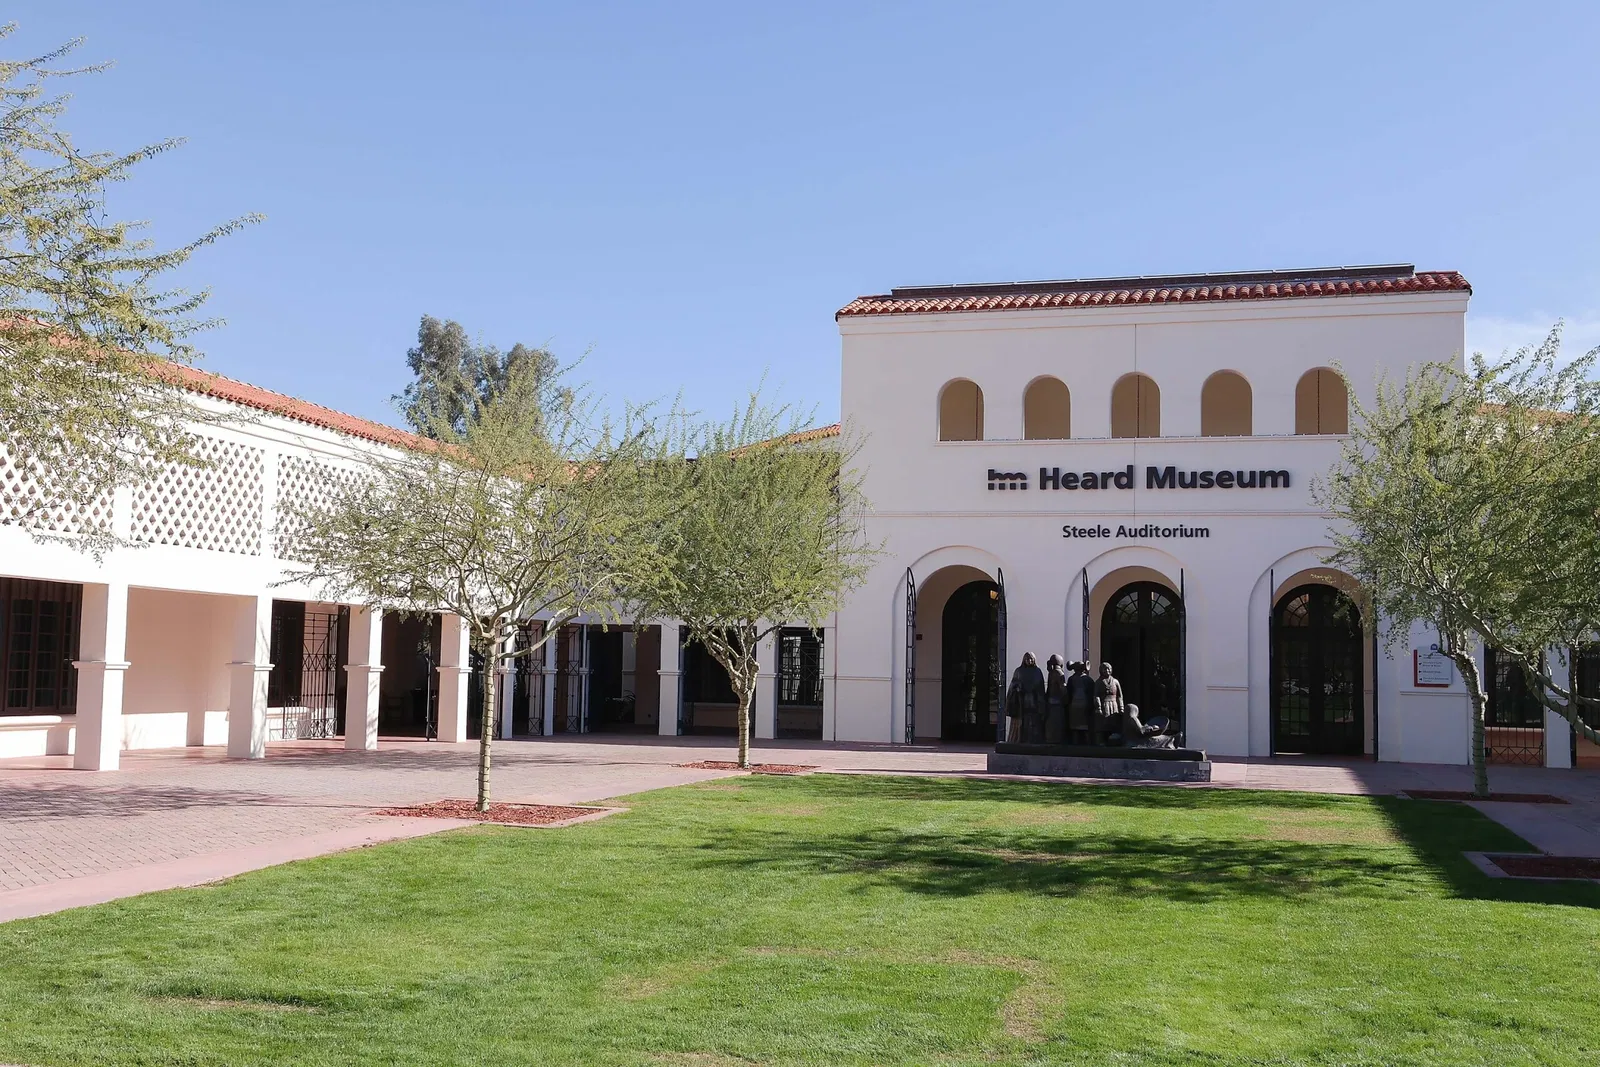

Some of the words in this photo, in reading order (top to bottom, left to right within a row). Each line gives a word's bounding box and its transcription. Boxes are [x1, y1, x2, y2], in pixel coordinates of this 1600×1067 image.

[1039, 464, 1134, 491] Heard
[1146, 465, 1291, 490] Museum
[1062, 524, 1111, 539] Steele
[1115, 523, 1210, 538] Auditorium
